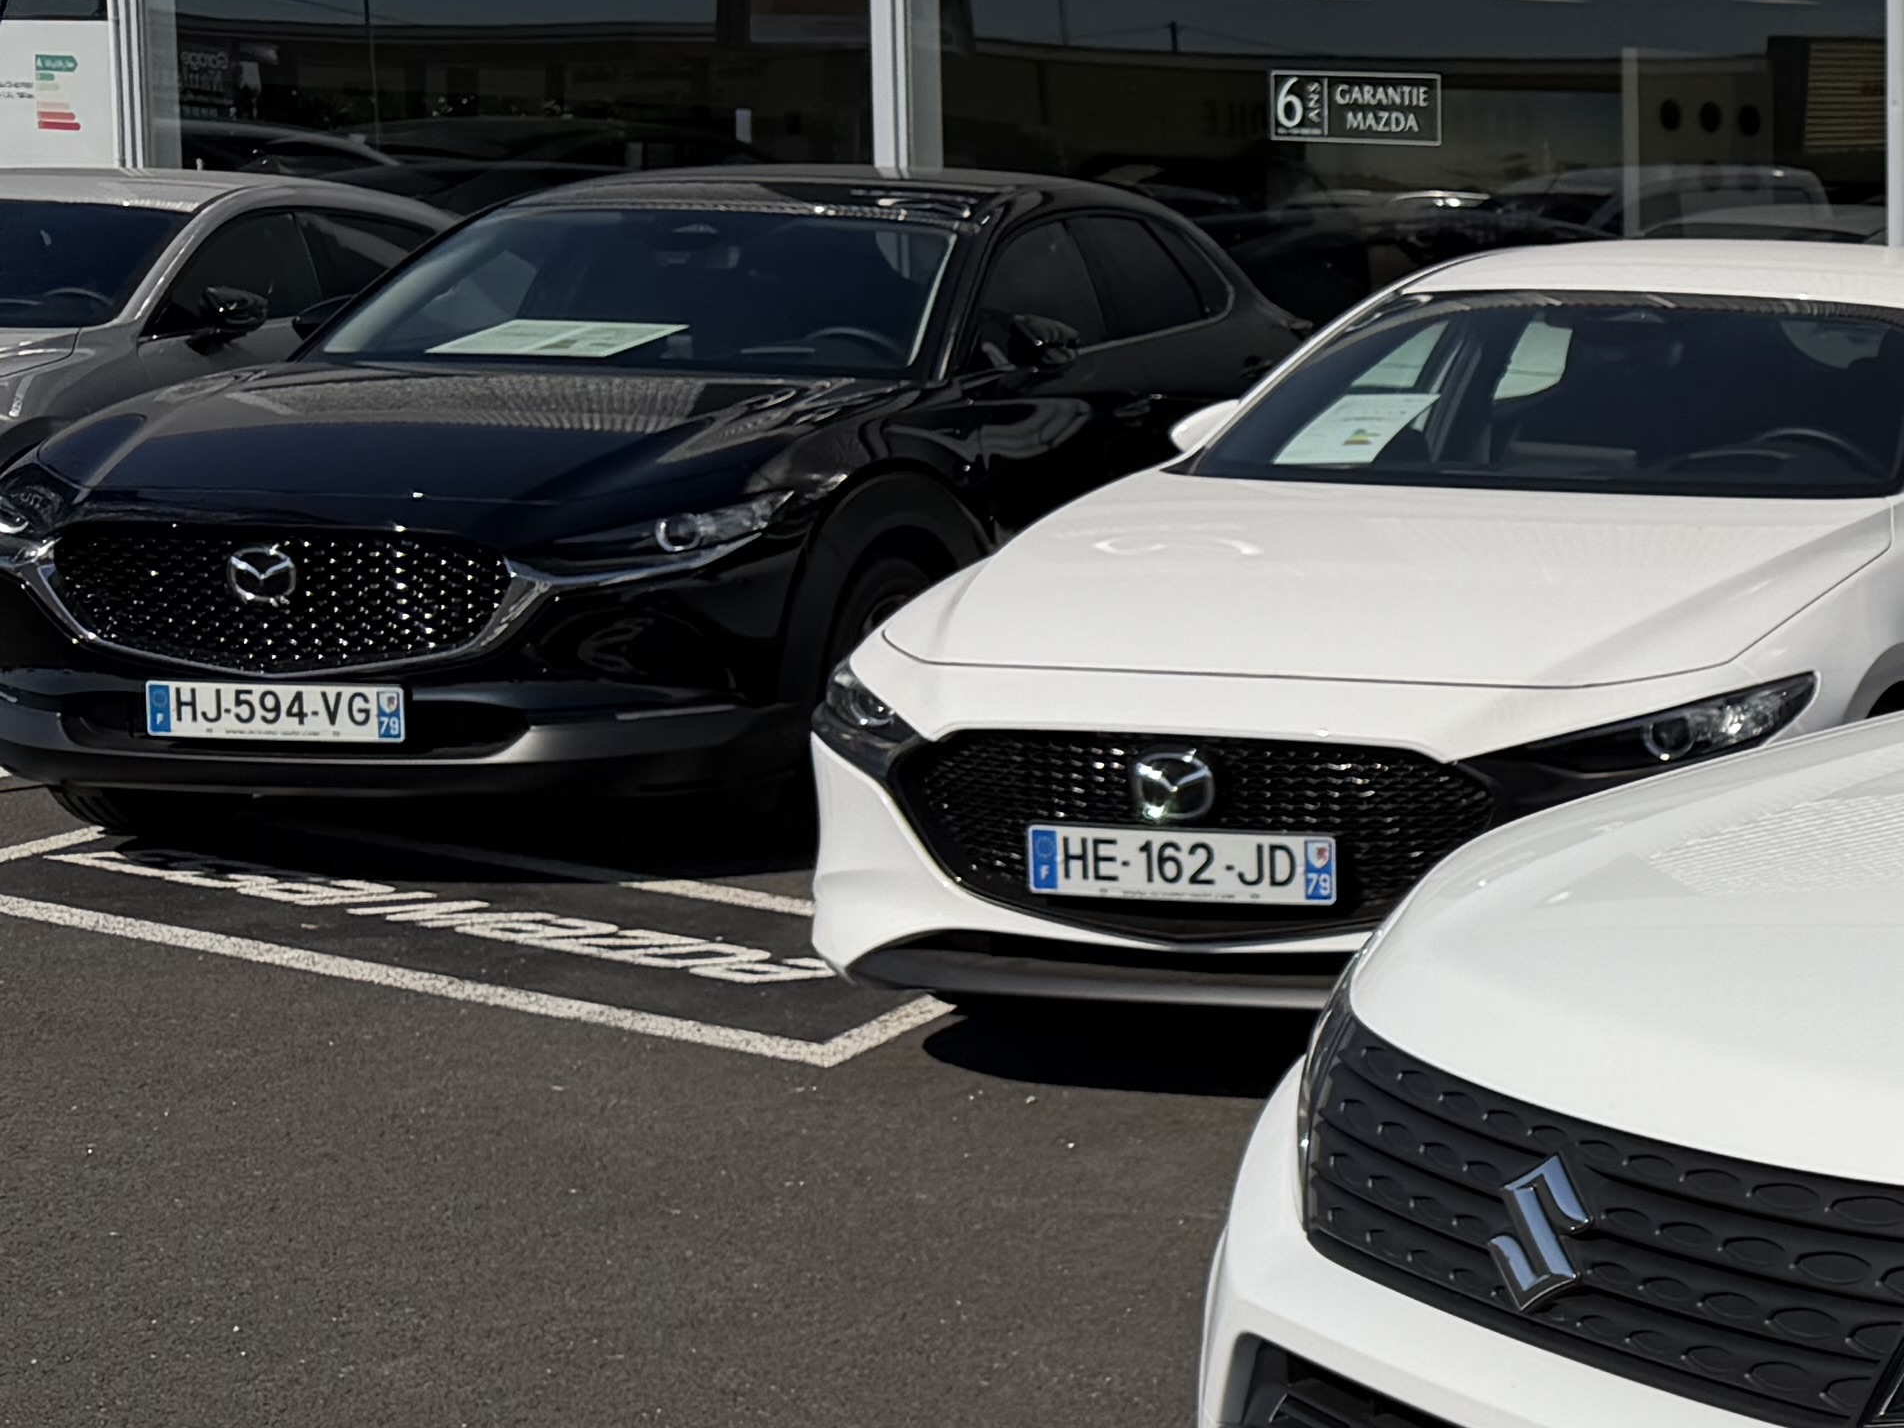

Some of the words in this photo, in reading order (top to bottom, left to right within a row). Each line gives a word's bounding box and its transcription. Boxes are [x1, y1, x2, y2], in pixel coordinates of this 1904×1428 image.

[1276, 76, 1304, 128] 6
[1307, 81, 1322, 123] ANS
[1335, 83, 1430, 107] GARANTIE
[1346, 110, 1420, 133] MAZDA
[174, 686, 371, 726] HJ-594-VG
[378, 716, 400, 736] 79
[1062, 835, 1298, 888] HE-162-JD
[1305, 872, 1332, 897] 79
